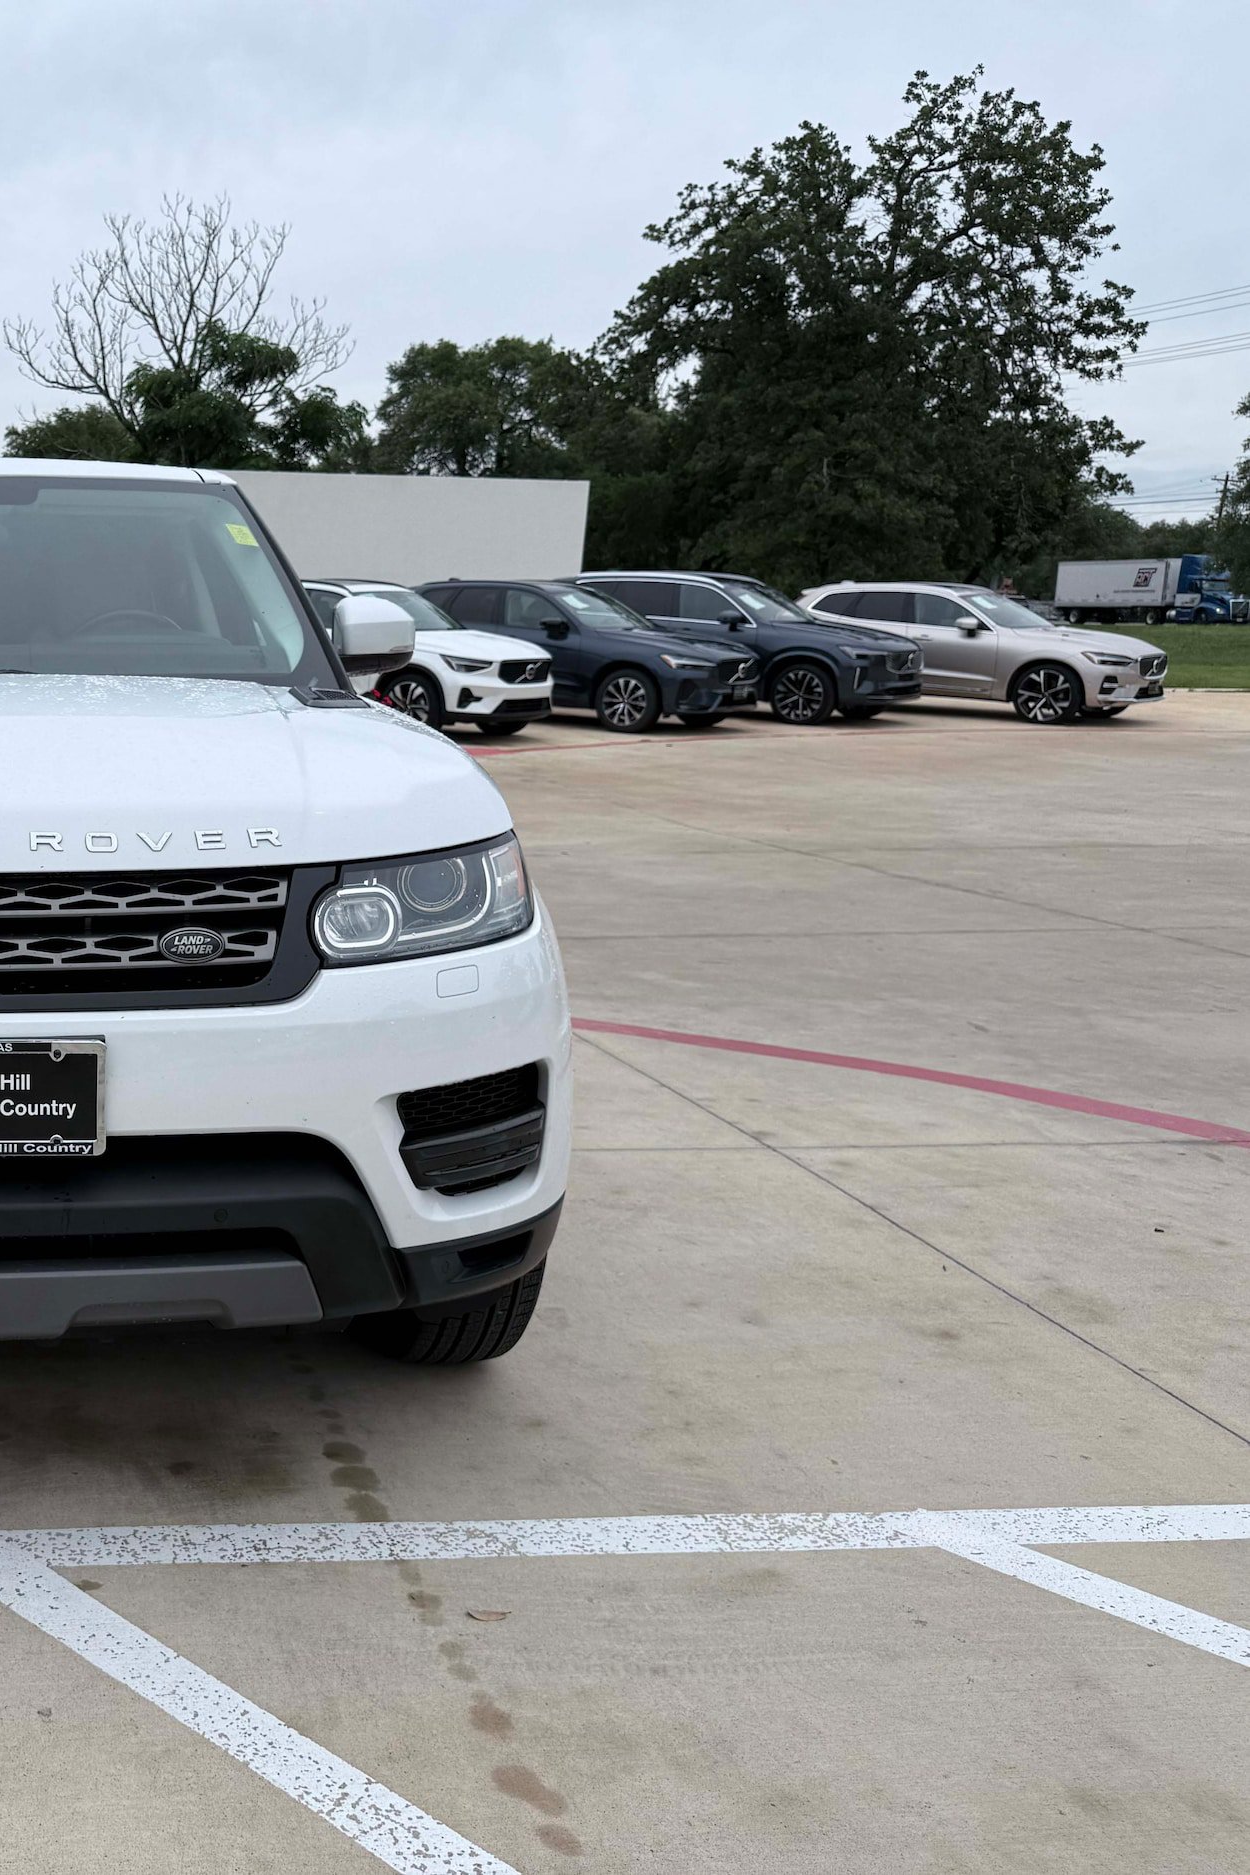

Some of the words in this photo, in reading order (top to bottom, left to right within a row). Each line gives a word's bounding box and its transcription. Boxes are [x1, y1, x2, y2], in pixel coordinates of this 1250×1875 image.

[28, 827, 283, 853] ROVER
[174, 936, 204, 945] LAND
[177, 945, 213, 954] ROVER
[0, 1073, 32, 1091] Hill
[0, 1099, 77, 1120] Country
[23, 1142, 93, 1156] Country
